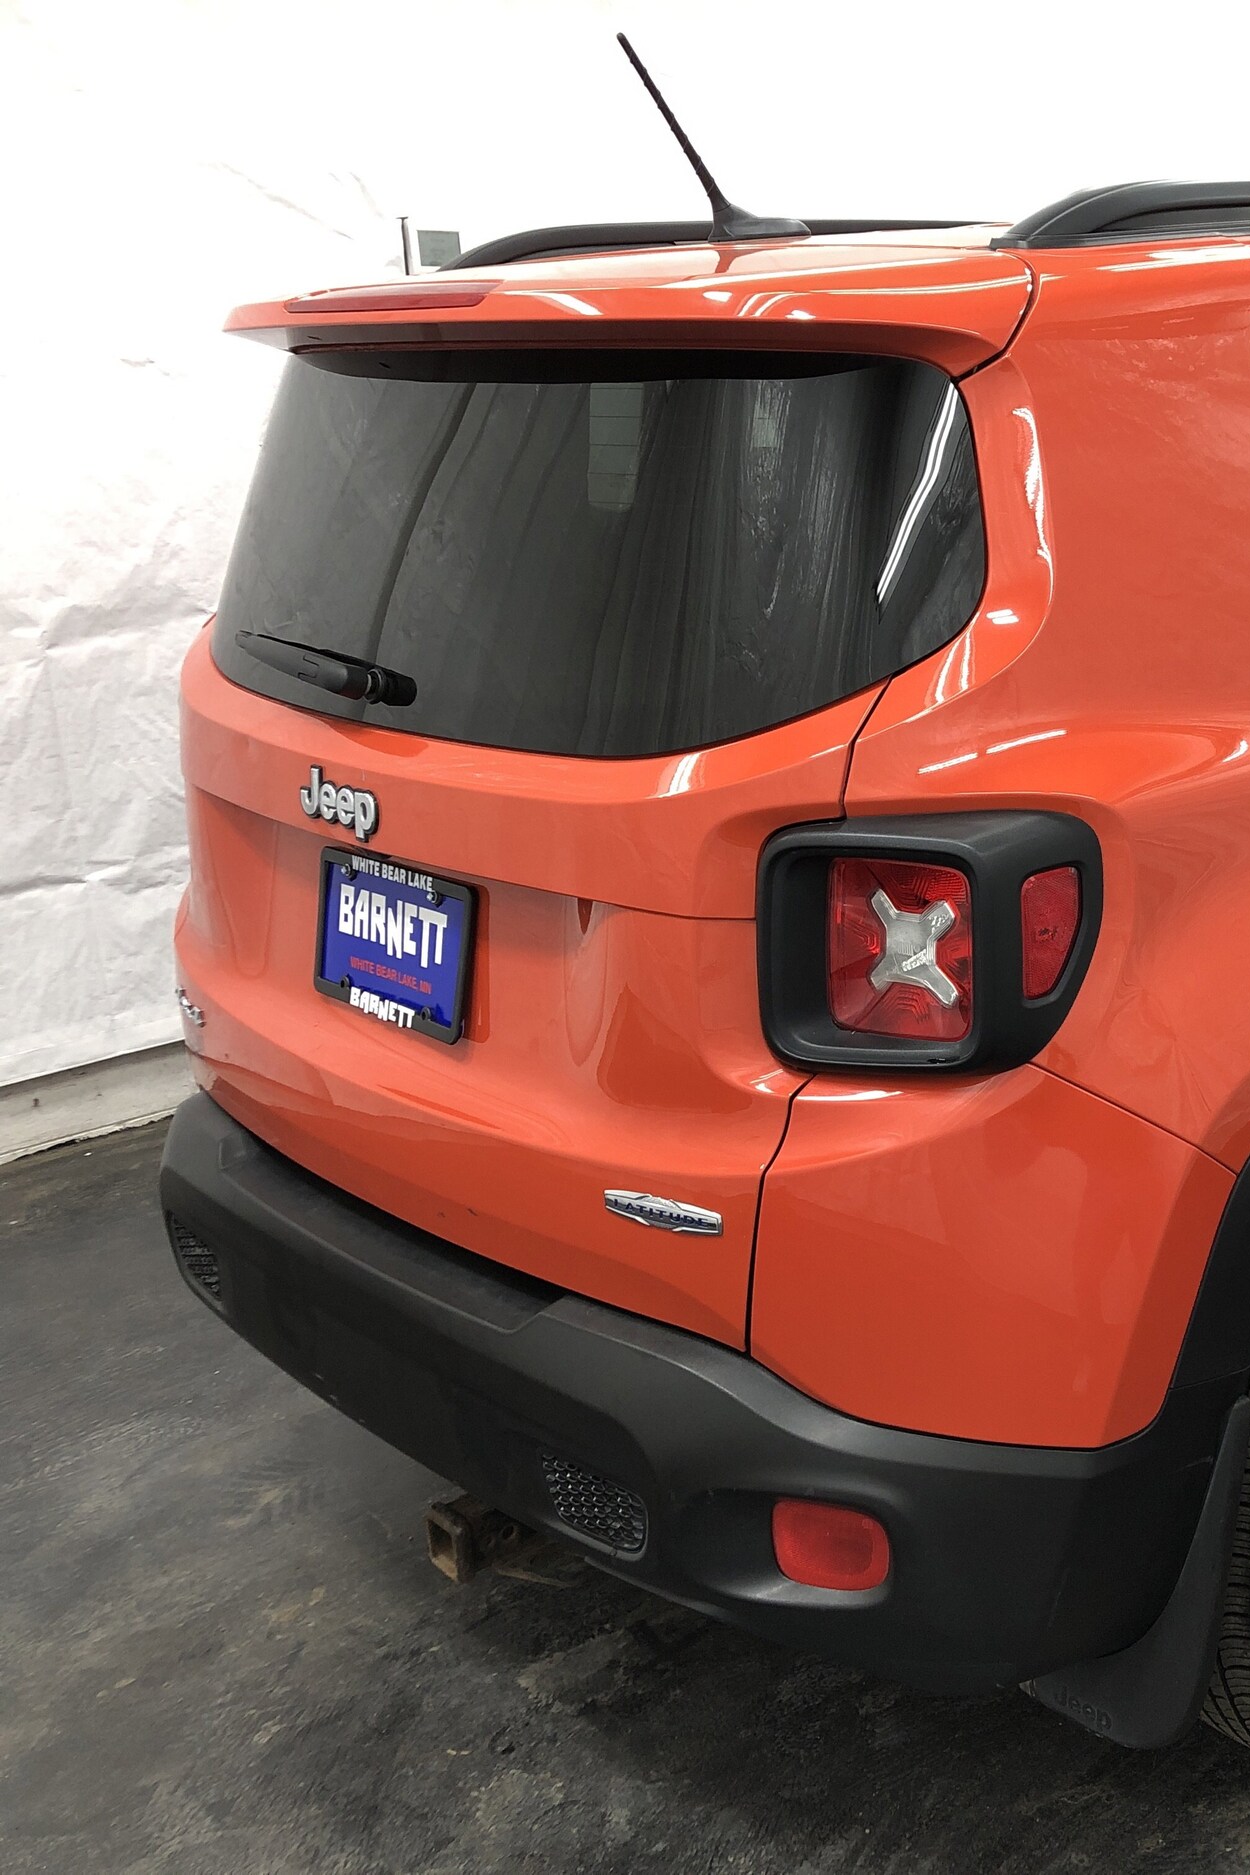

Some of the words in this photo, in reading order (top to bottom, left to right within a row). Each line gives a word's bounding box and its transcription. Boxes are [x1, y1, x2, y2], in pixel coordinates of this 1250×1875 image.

[300, 764, 378, 842] Jeep
[351, 855, 380, 877] WHITE
[381, 863, 406, 885] BEAR
[407, 871, 433, 892] LAKE
[338, 883, 448, 968] BARNETT
[350, 956, 375, 974] WHITE
[375, 964, 398, 981] BEAR
[349, 986, 415, 1028] BARNETT
[612, 1198, 709, 1227] LATITUDE
